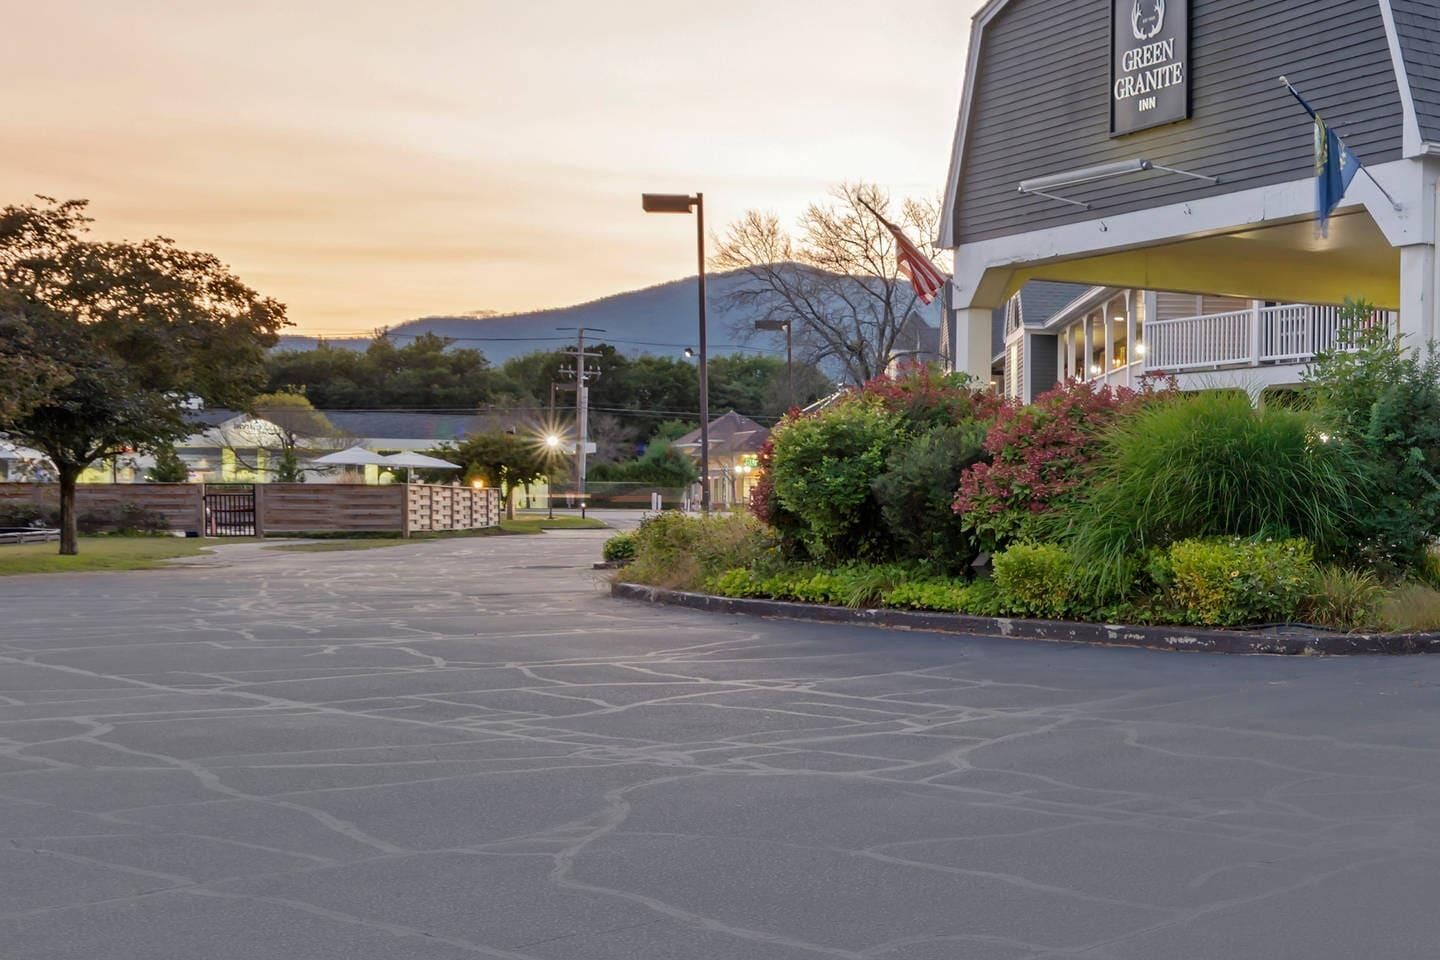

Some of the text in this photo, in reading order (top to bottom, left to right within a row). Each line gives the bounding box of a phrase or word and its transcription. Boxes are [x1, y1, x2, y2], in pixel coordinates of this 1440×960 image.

[1122, 38, 1174, 72] GREEN
[1114, 62, 1183, 100] GRANITE
[1138, 97, 1156, 111] INN
